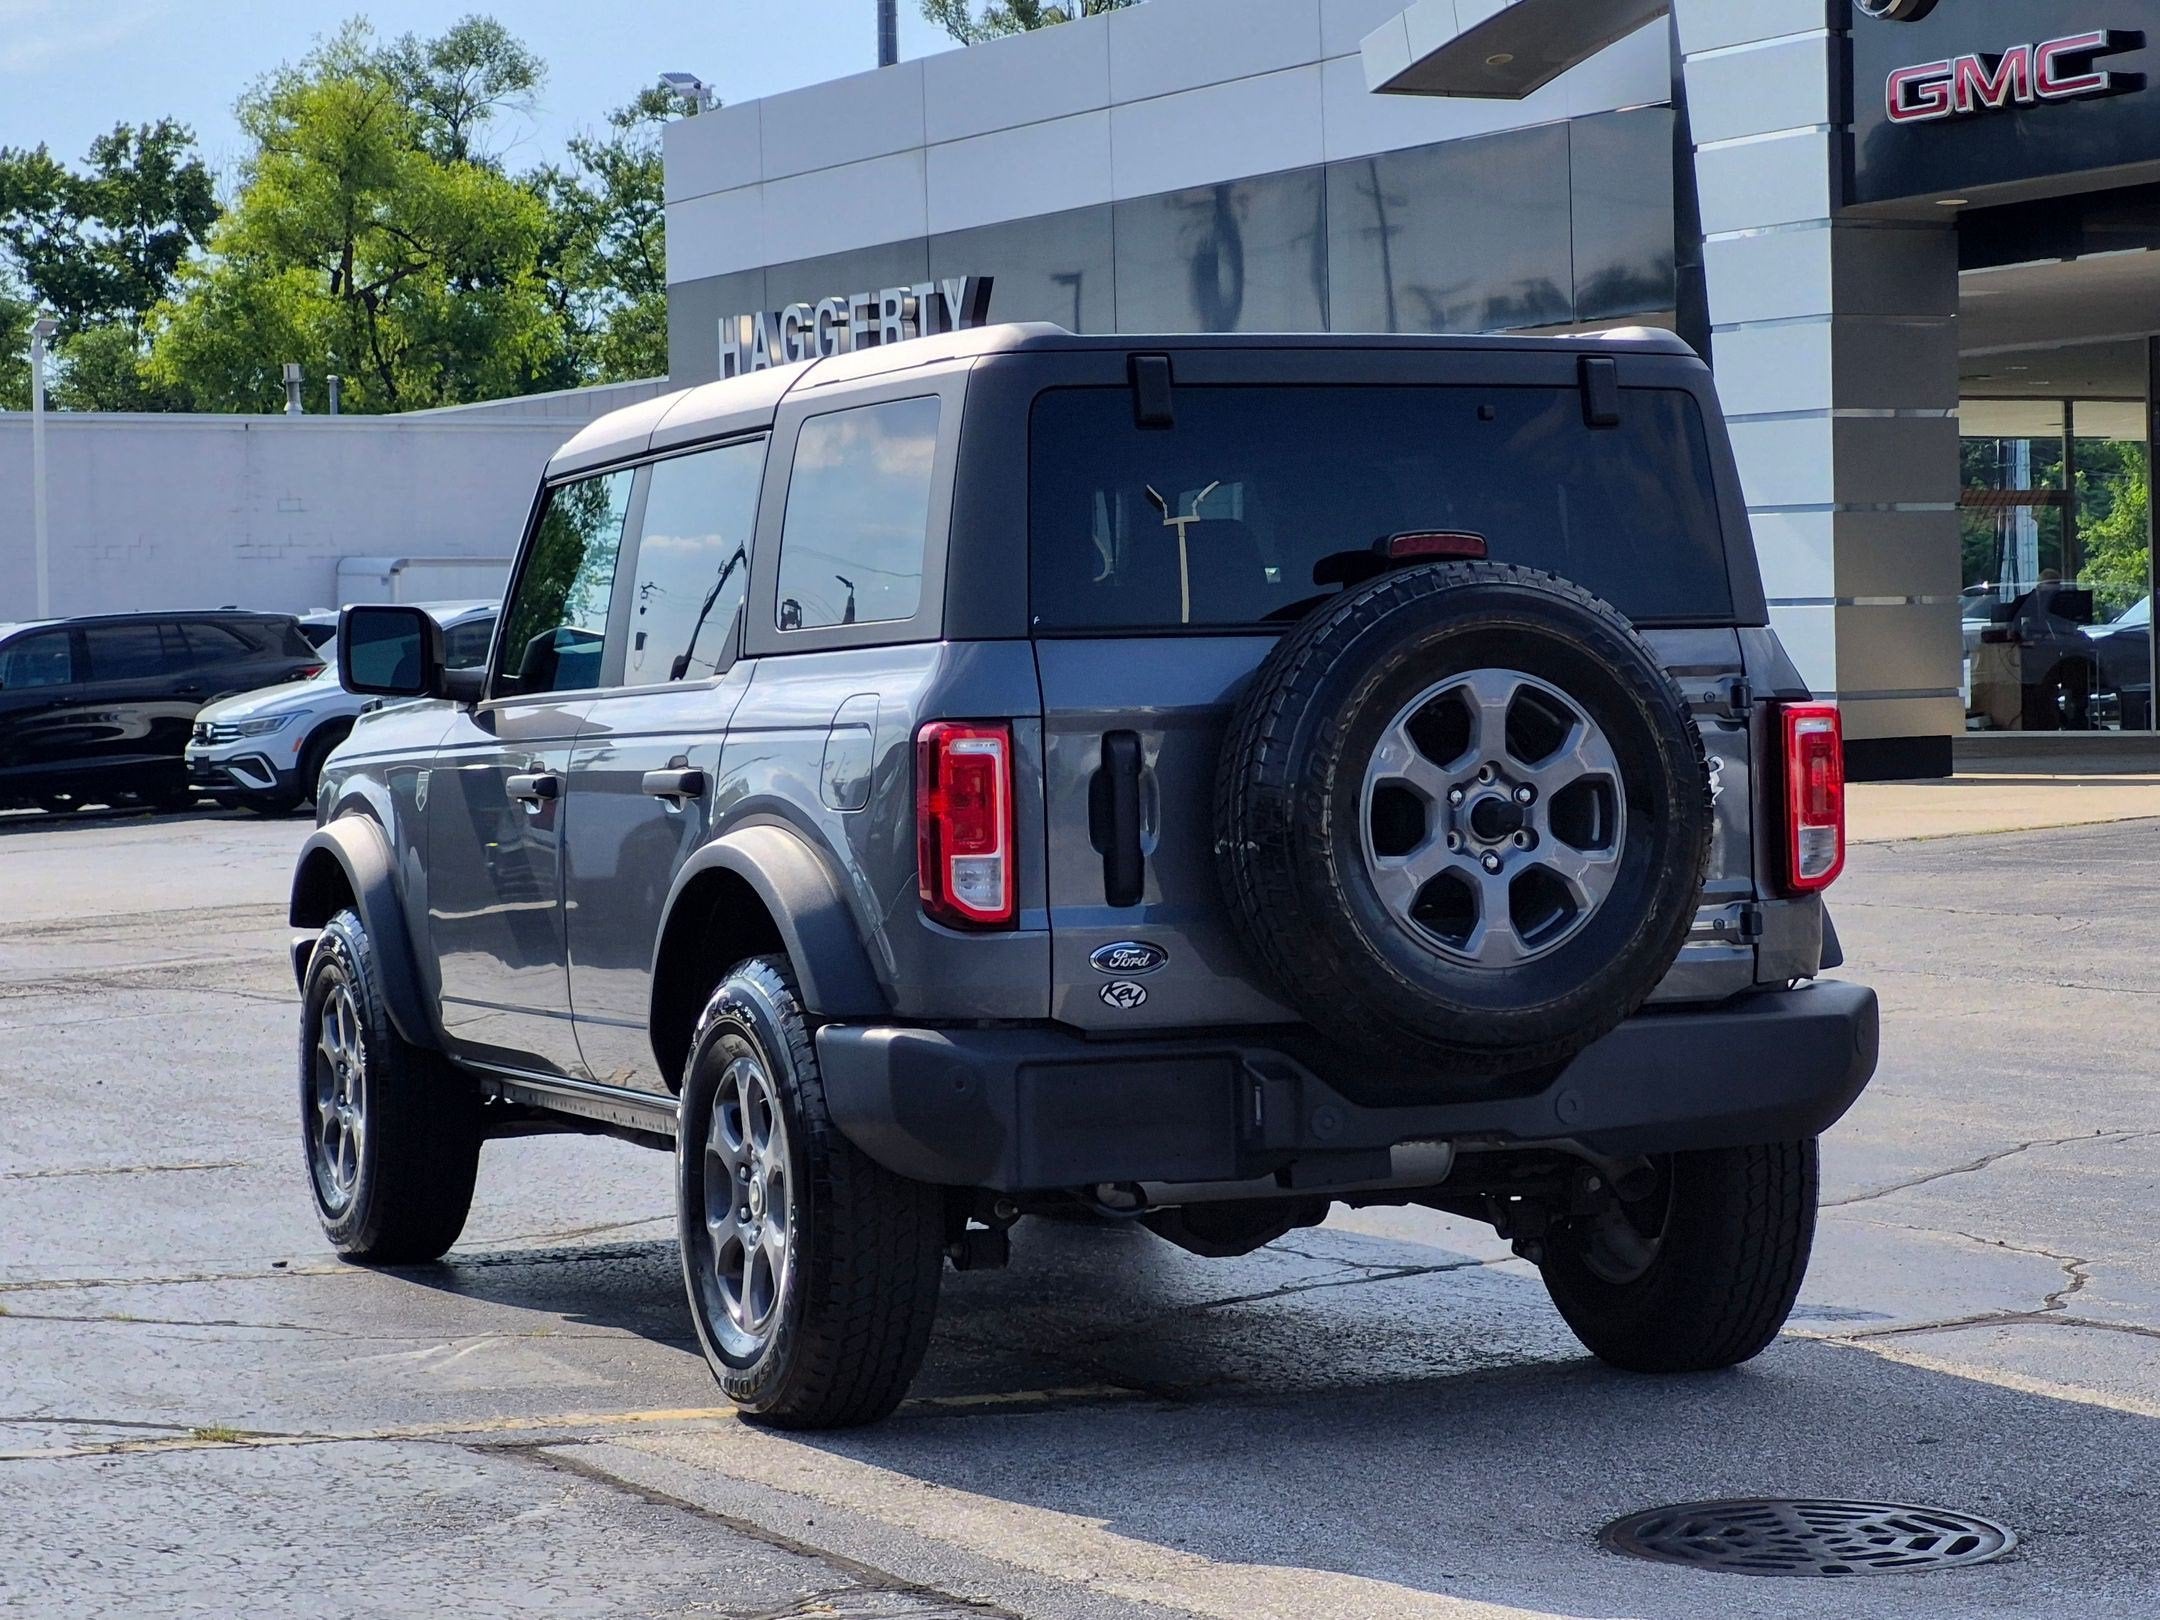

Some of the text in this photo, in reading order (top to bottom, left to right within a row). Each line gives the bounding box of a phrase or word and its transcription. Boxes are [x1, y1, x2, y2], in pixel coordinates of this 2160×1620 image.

[1886, 30, 2110, 124] GMC
[717, 275, 983, 381] HAGGERTY
[1108, 948, 1151, 968] Ford
[1101, 981, 1144, 1008] Key
